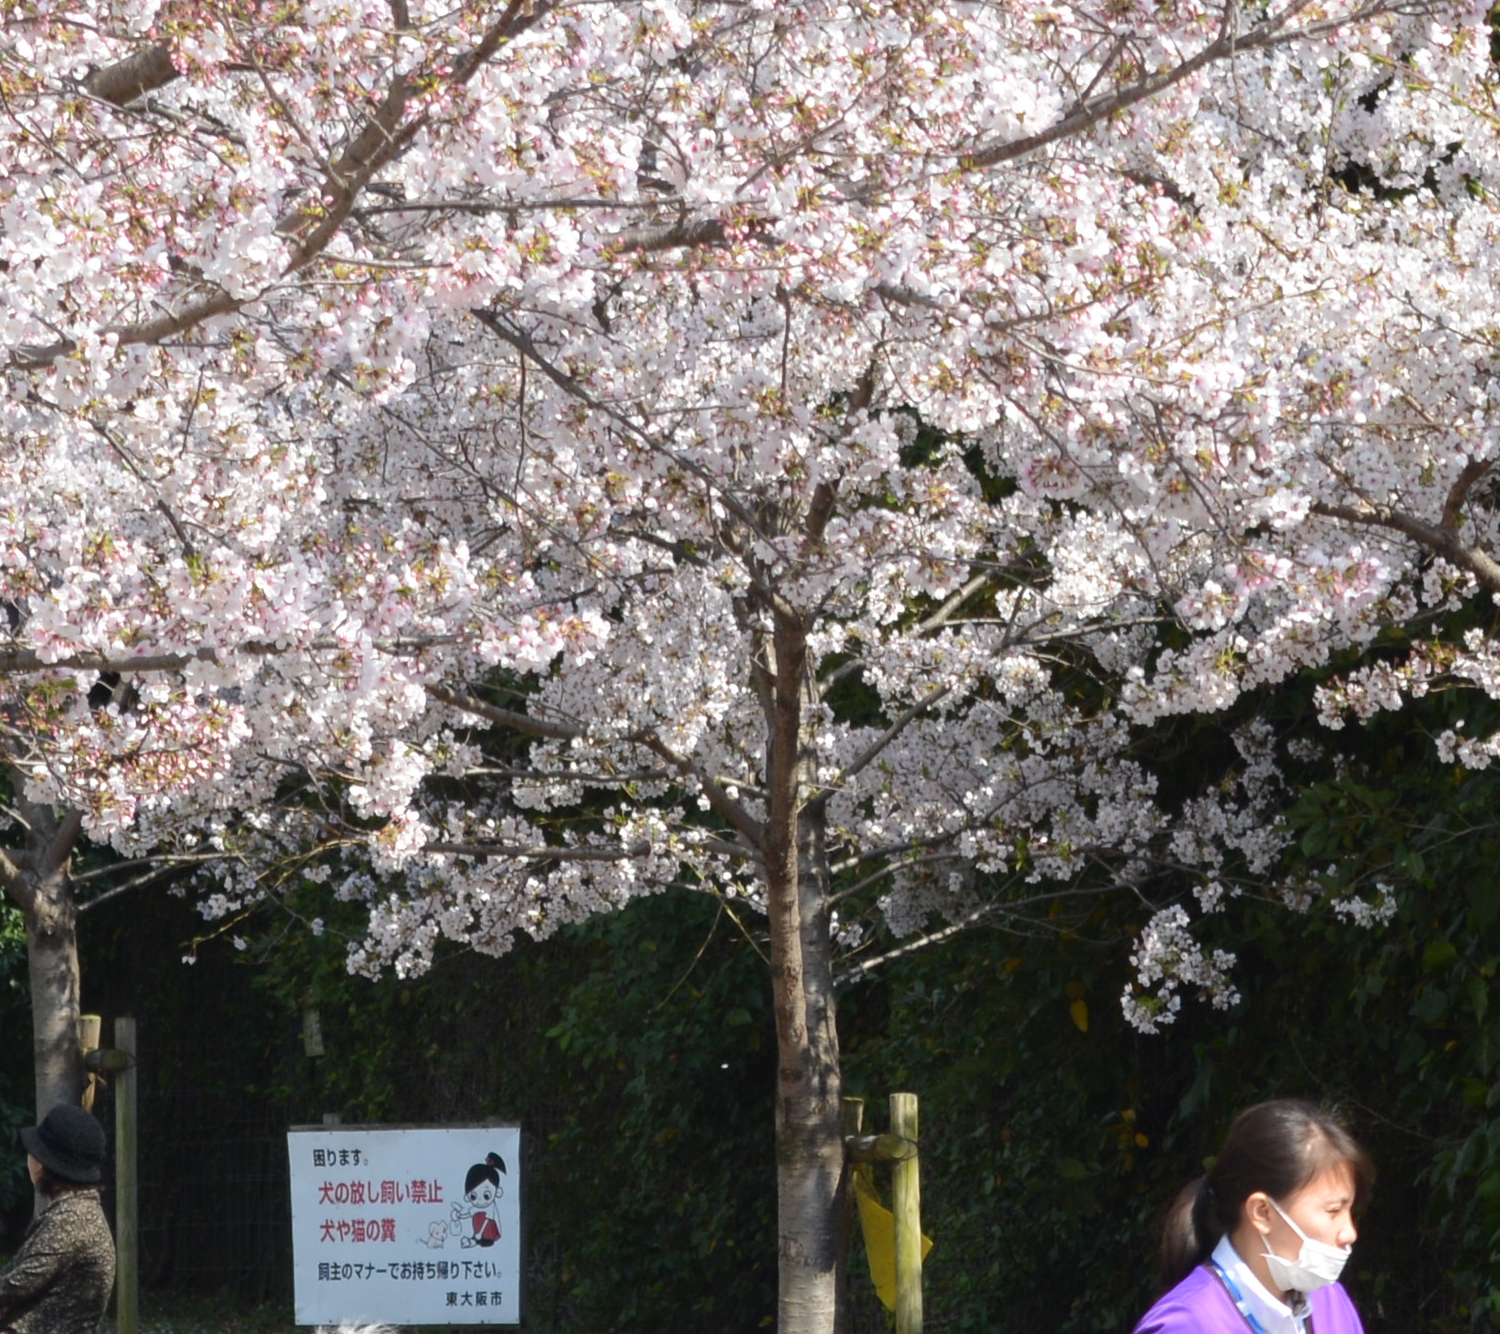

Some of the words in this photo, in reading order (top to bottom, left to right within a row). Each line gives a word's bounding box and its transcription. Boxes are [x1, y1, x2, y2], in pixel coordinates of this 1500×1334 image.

[313, 1149, 368, 1167] 困ります。
[318, 1179, 443, 1205] 犬の放し飼い禁止
[319, 1218, 396, 1243] 犬や猫の糞
[318, 1261, 502, 1281] 飼主のマナーでお持ち帰り下さい。
[446, 1291, 503, 1307] 東大阪市
